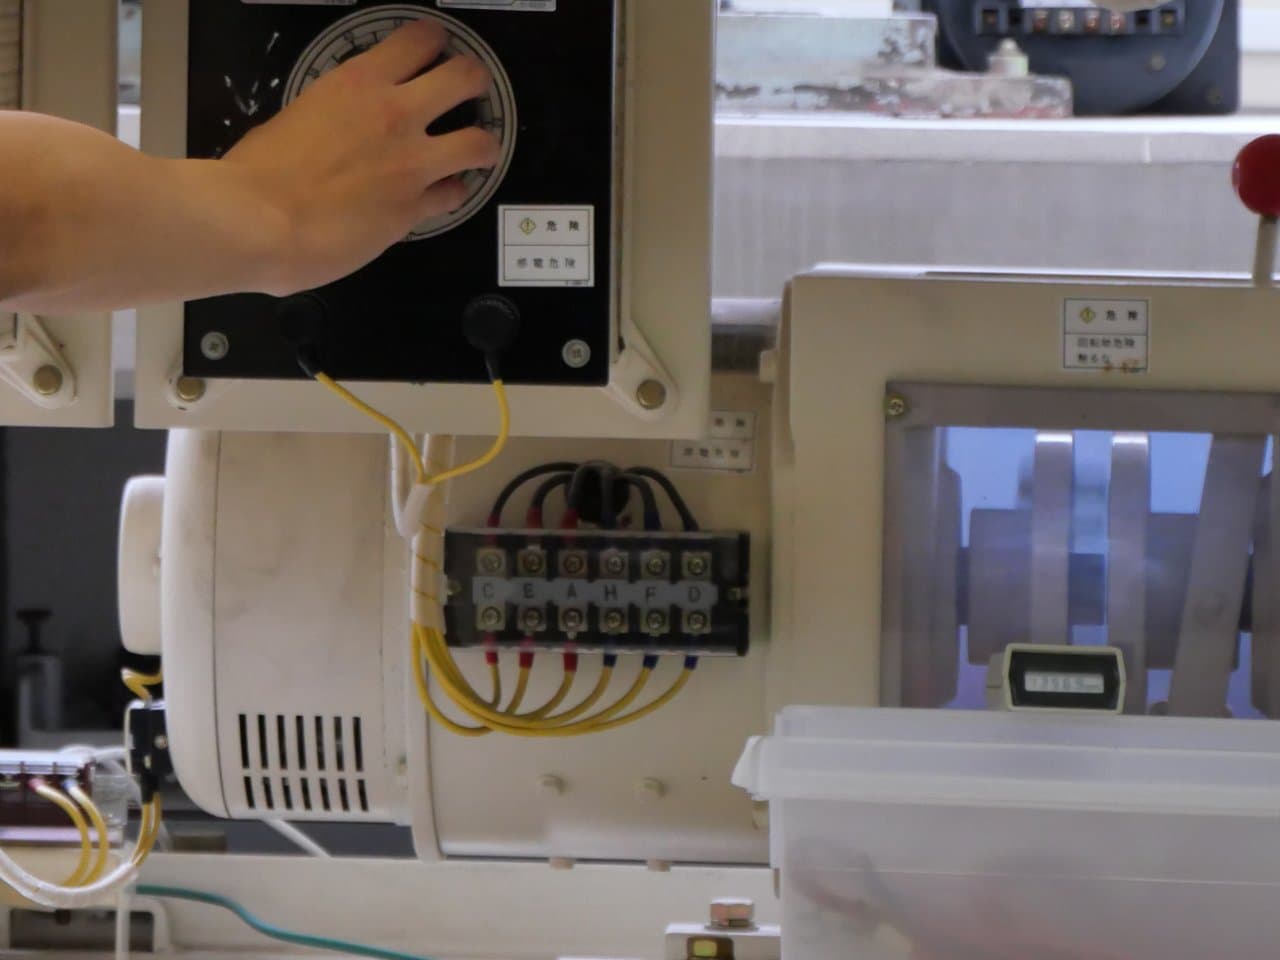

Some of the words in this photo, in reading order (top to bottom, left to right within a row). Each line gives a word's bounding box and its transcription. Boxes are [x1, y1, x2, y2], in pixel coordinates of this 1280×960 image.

[523, 583, 535, 599] E
[566, 582, 578, 599] A
[604, 584, 618, 601] H
[645, 586, 657, 602] F
[688, 586, 702, 602] D
